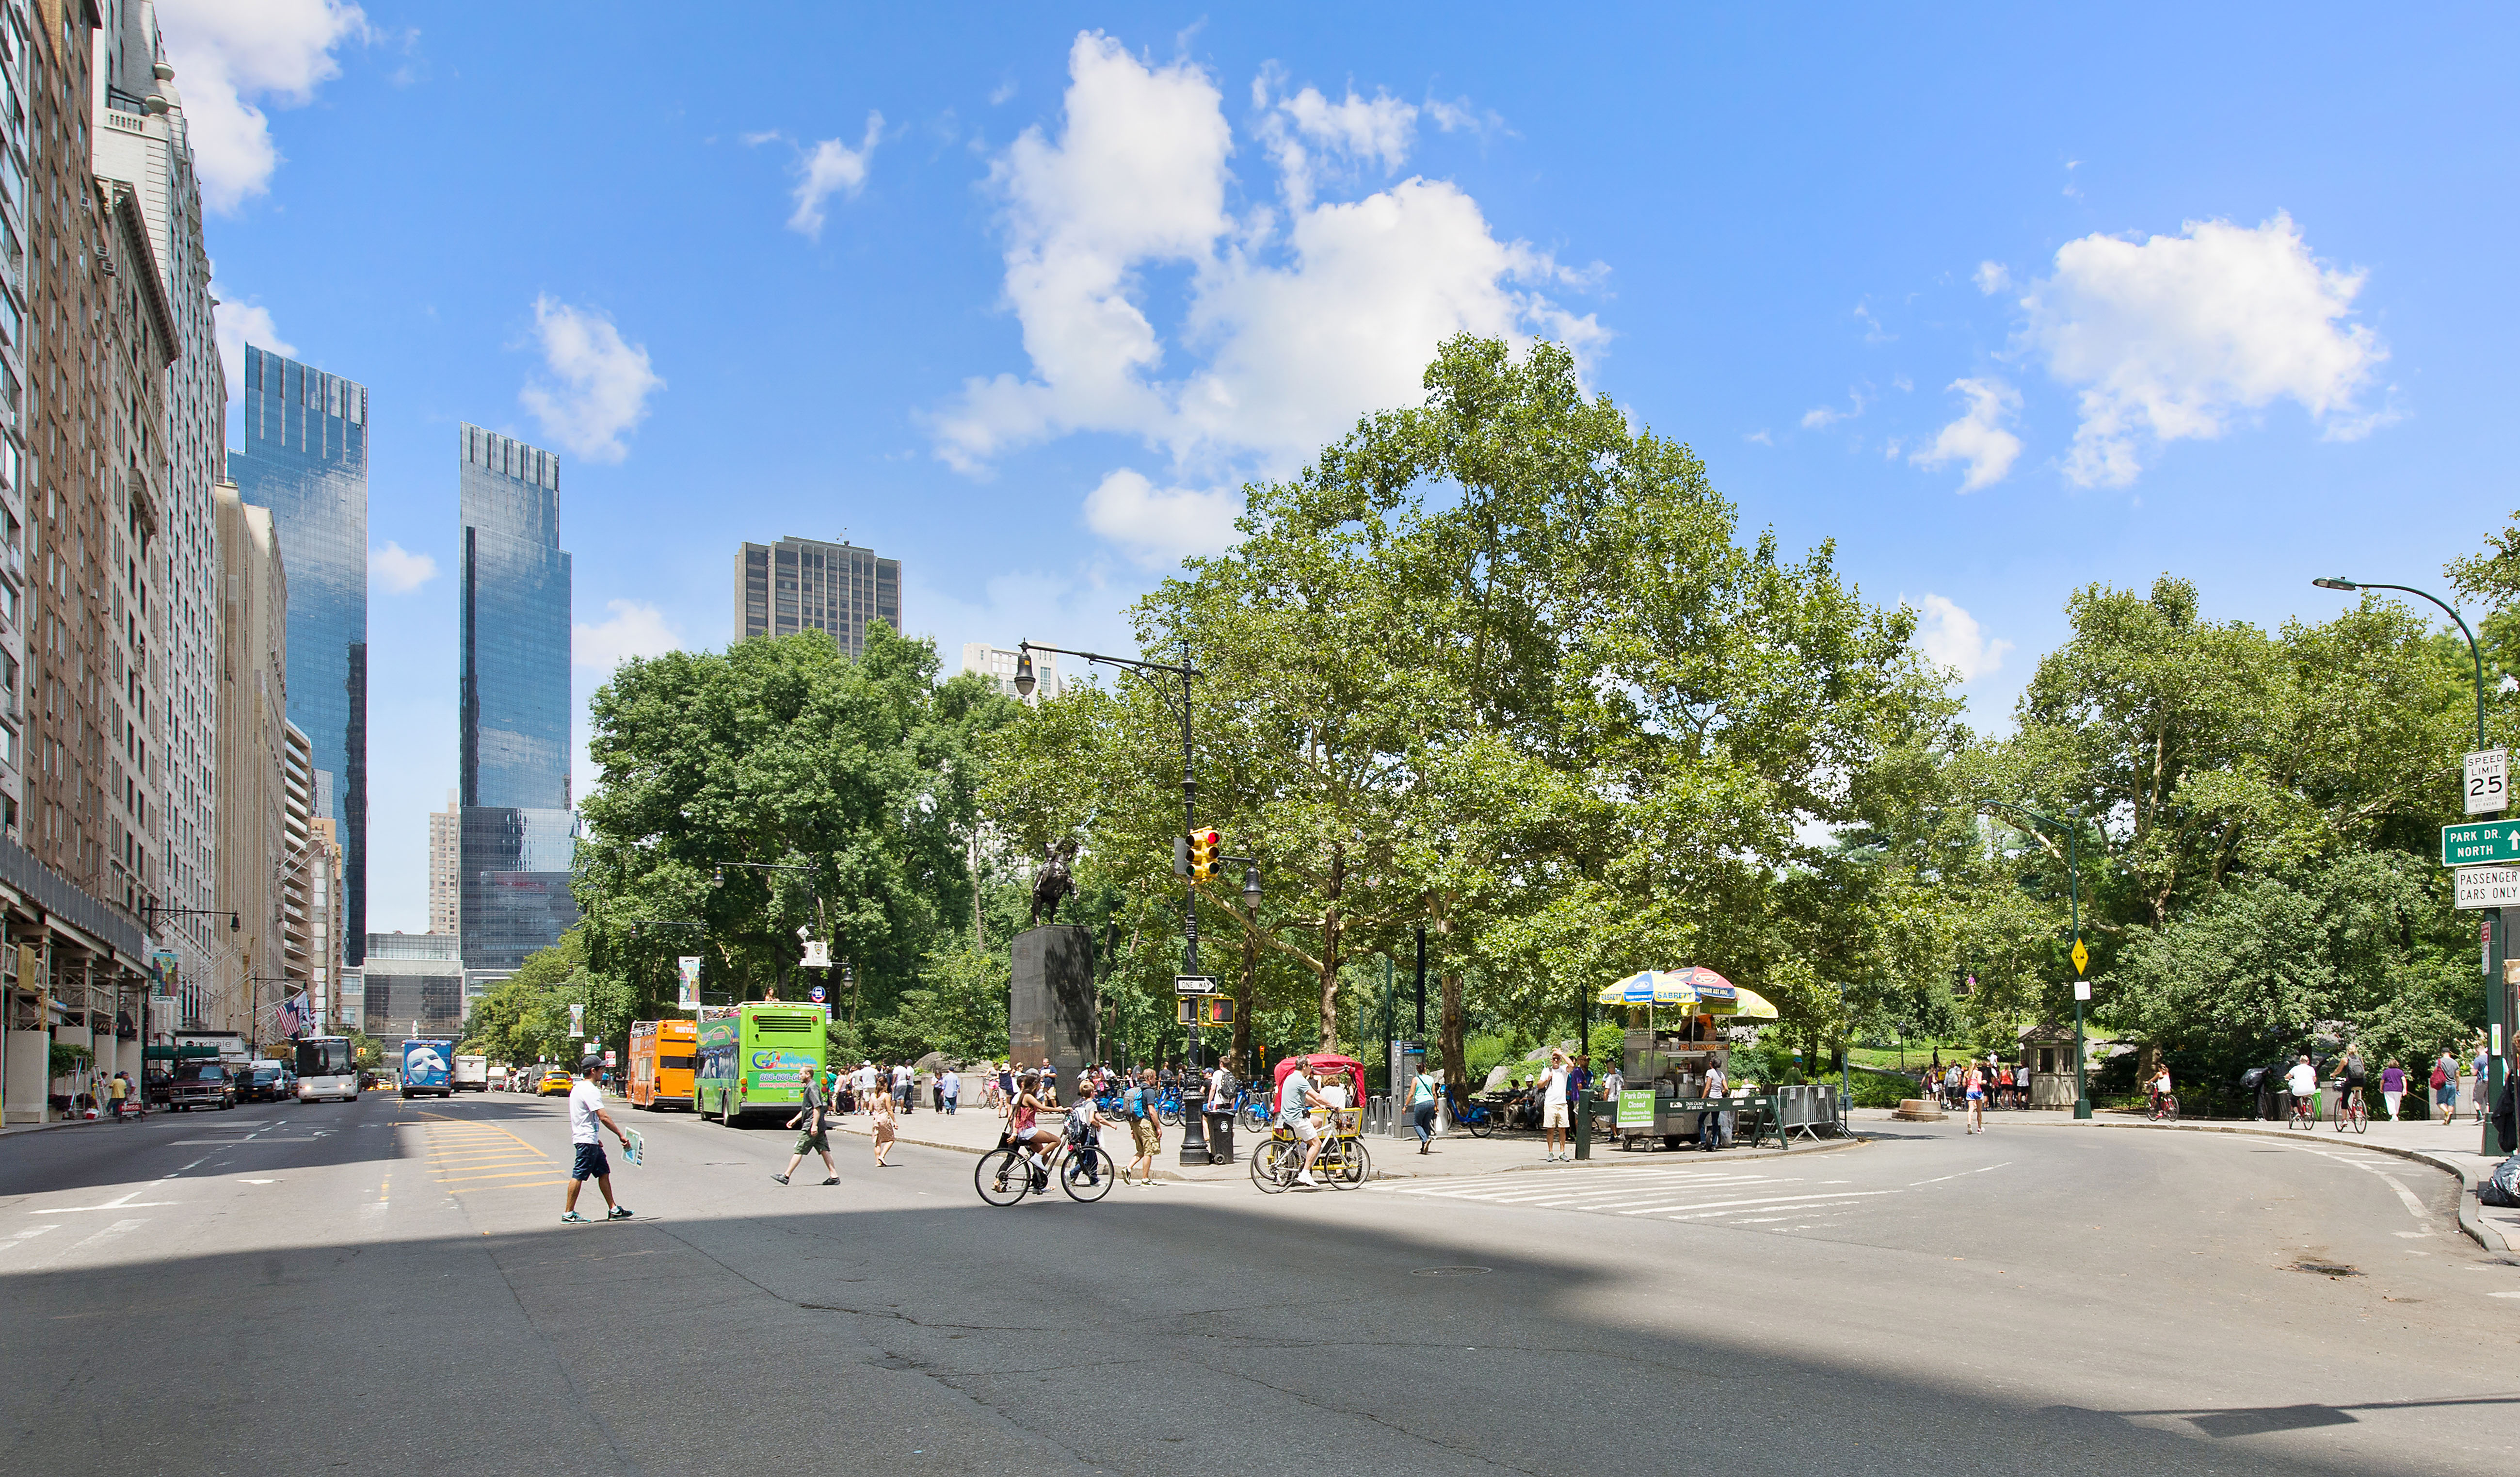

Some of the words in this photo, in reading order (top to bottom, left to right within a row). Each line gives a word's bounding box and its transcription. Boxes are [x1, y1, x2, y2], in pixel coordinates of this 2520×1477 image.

[2468, 754, 2503, 766] SPEED
[2472, 765, 2499, 776] LIMIT
[2470, 775, 2502, 796] 25
[2450, 831, 2477, 843] PARK
[2484, 829, 2501, 840] DR.
[2457, 845, 2493, 857] NORTH
[2460, 871, 2517, 885] PASSENGER
[2460, 889, 2485, 900] CARS
[2493, 887, 2517, 898] ONLY
